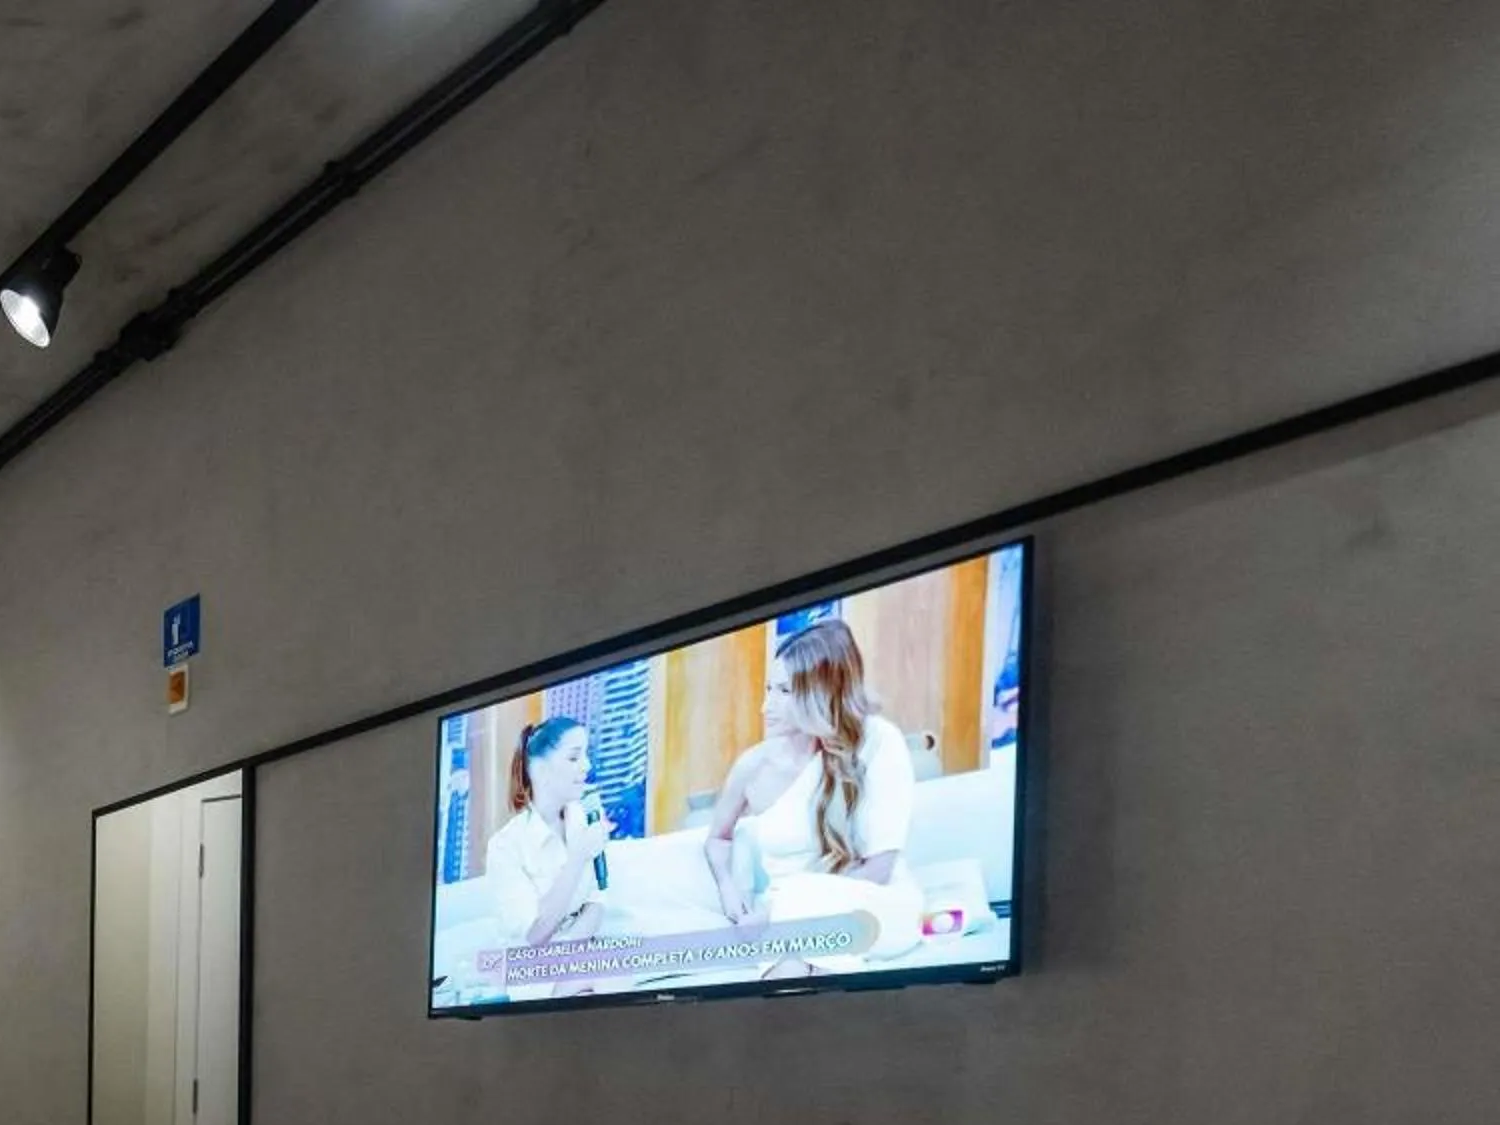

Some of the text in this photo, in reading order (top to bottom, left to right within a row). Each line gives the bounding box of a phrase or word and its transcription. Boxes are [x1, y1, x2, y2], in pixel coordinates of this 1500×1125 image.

[507, 966, 548, 981] MORTE
[550, 964, 566, 977] DA
[569, 959, 619, 975] MENINA
[622, 951, 694, 968] COMPLETA
[716, 942, 759, 958] ANOS
[763, 938, 787, 953] EM
